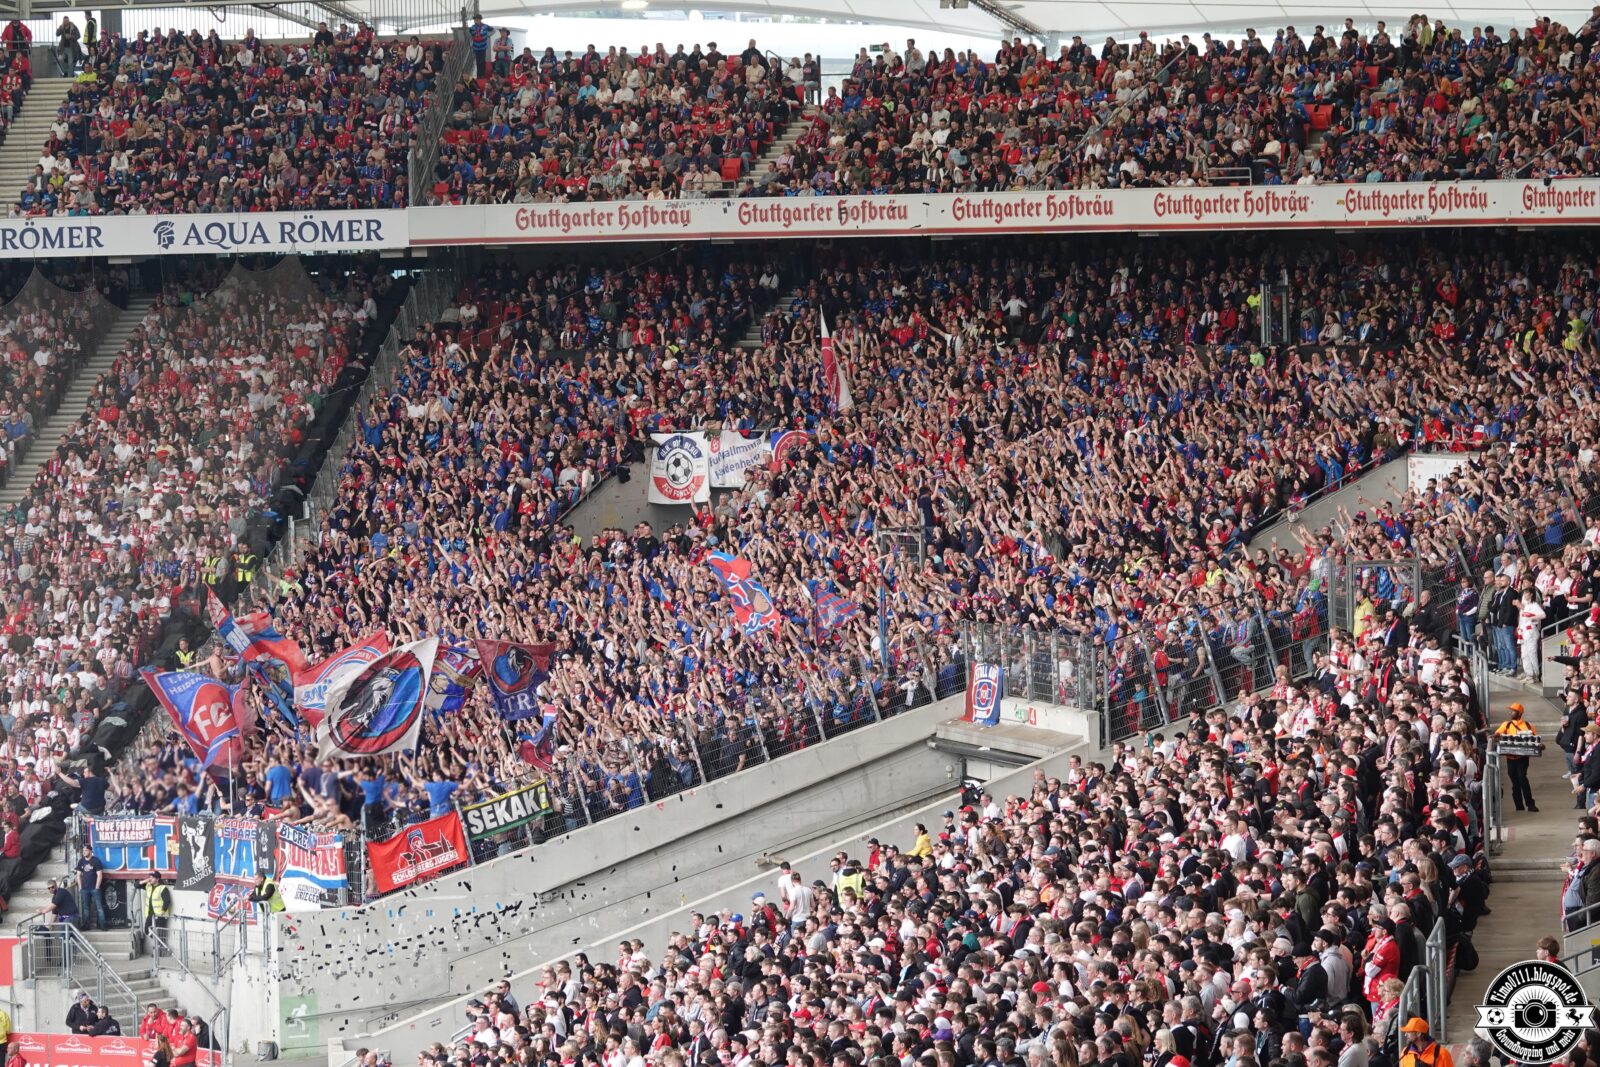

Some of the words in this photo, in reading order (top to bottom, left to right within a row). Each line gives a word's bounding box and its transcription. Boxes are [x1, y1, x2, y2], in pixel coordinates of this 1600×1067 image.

[738, 201, 833, 228] Stuttgarter
[838, 198, 908, 225] Hofbräu
[952, 197, 1041, 223] Stuttgarter
[1046, 194, 1113, 221] Hofbräu
[1153, 192, 1239, 218] Stuttgarter
[1243, 190, 1308, 216] Hofbräu
[1345, 188, 1424, 216] Stuttgarter
[1428, 184, 1488, 215] Hofbräu
[183, 223, 271, 249] AQUA
[278, 215, 384, 243] RÖMER
[515, 206, 613, 233] Stuttgarter
[617, 204, 691, 231] Hofbräu
[1, 221, 104, 250] RÖMER
[95, 822, 115, 831] LOVE
[116, 820, 154, 831] FOOTBALL
[99, 832, 118, 841] HATE
[224, 827, 257, 838] STARS
